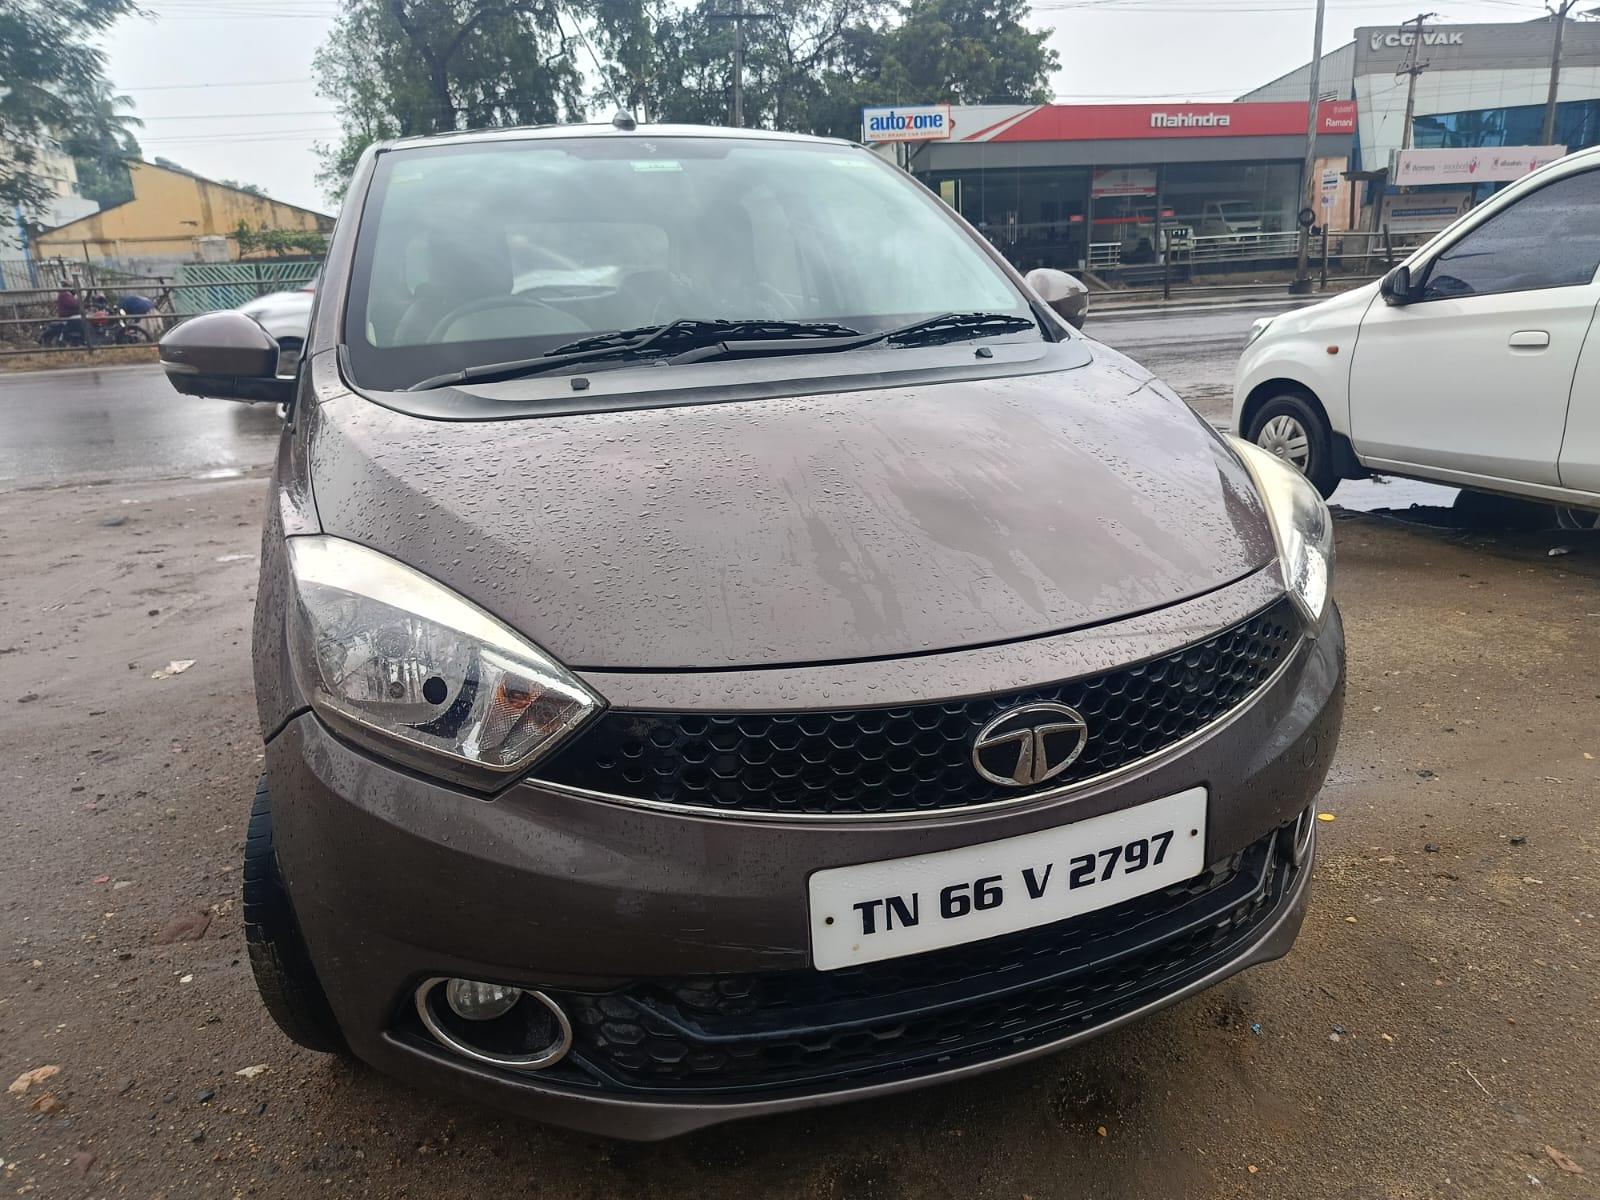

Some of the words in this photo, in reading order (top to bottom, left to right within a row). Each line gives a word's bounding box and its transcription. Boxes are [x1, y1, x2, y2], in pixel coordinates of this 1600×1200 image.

[1423, 32, 1464, 45] VAK
[870, 111, 943, 130] autozone
[1151, 112, 1230, 127] Mahindra
[1325, 117, 1353, 128] Ramani
[853, 893, 919, 935] TN
[939, 875, 1003, 919] 66
[1022, 863, 1053, 899] V
[1069, 830, 1174, 890] 2797
